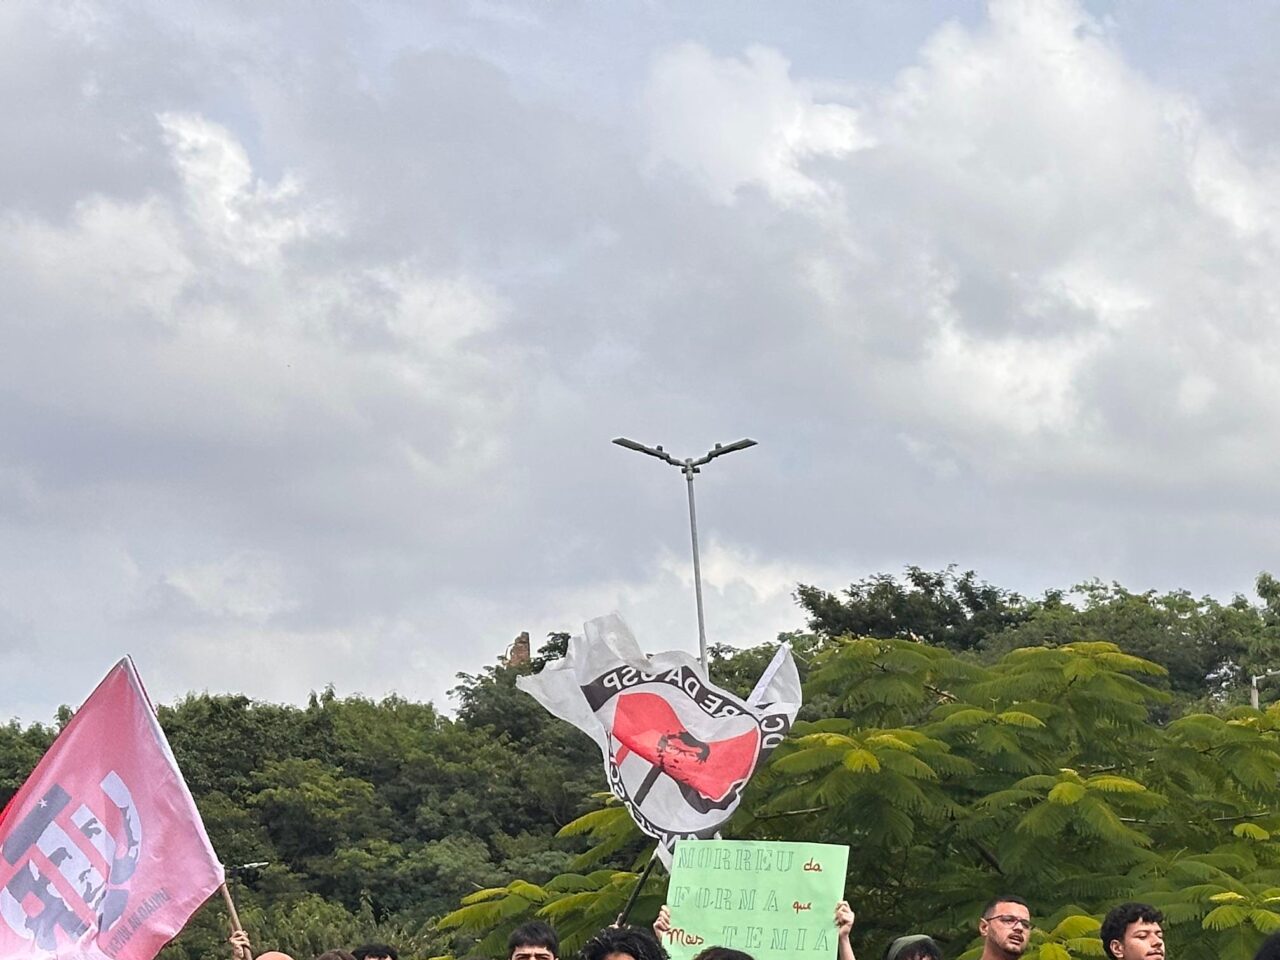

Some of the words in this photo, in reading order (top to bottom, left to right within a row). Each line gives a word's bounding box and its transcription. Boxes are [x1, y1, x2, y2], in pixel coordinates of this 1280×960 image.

[803, 857, 823, 872] da
[672, 886, 779, 912] FORMA
[792, 901, 812, 914] que
[721, 926, 829, 951] TEMIA
